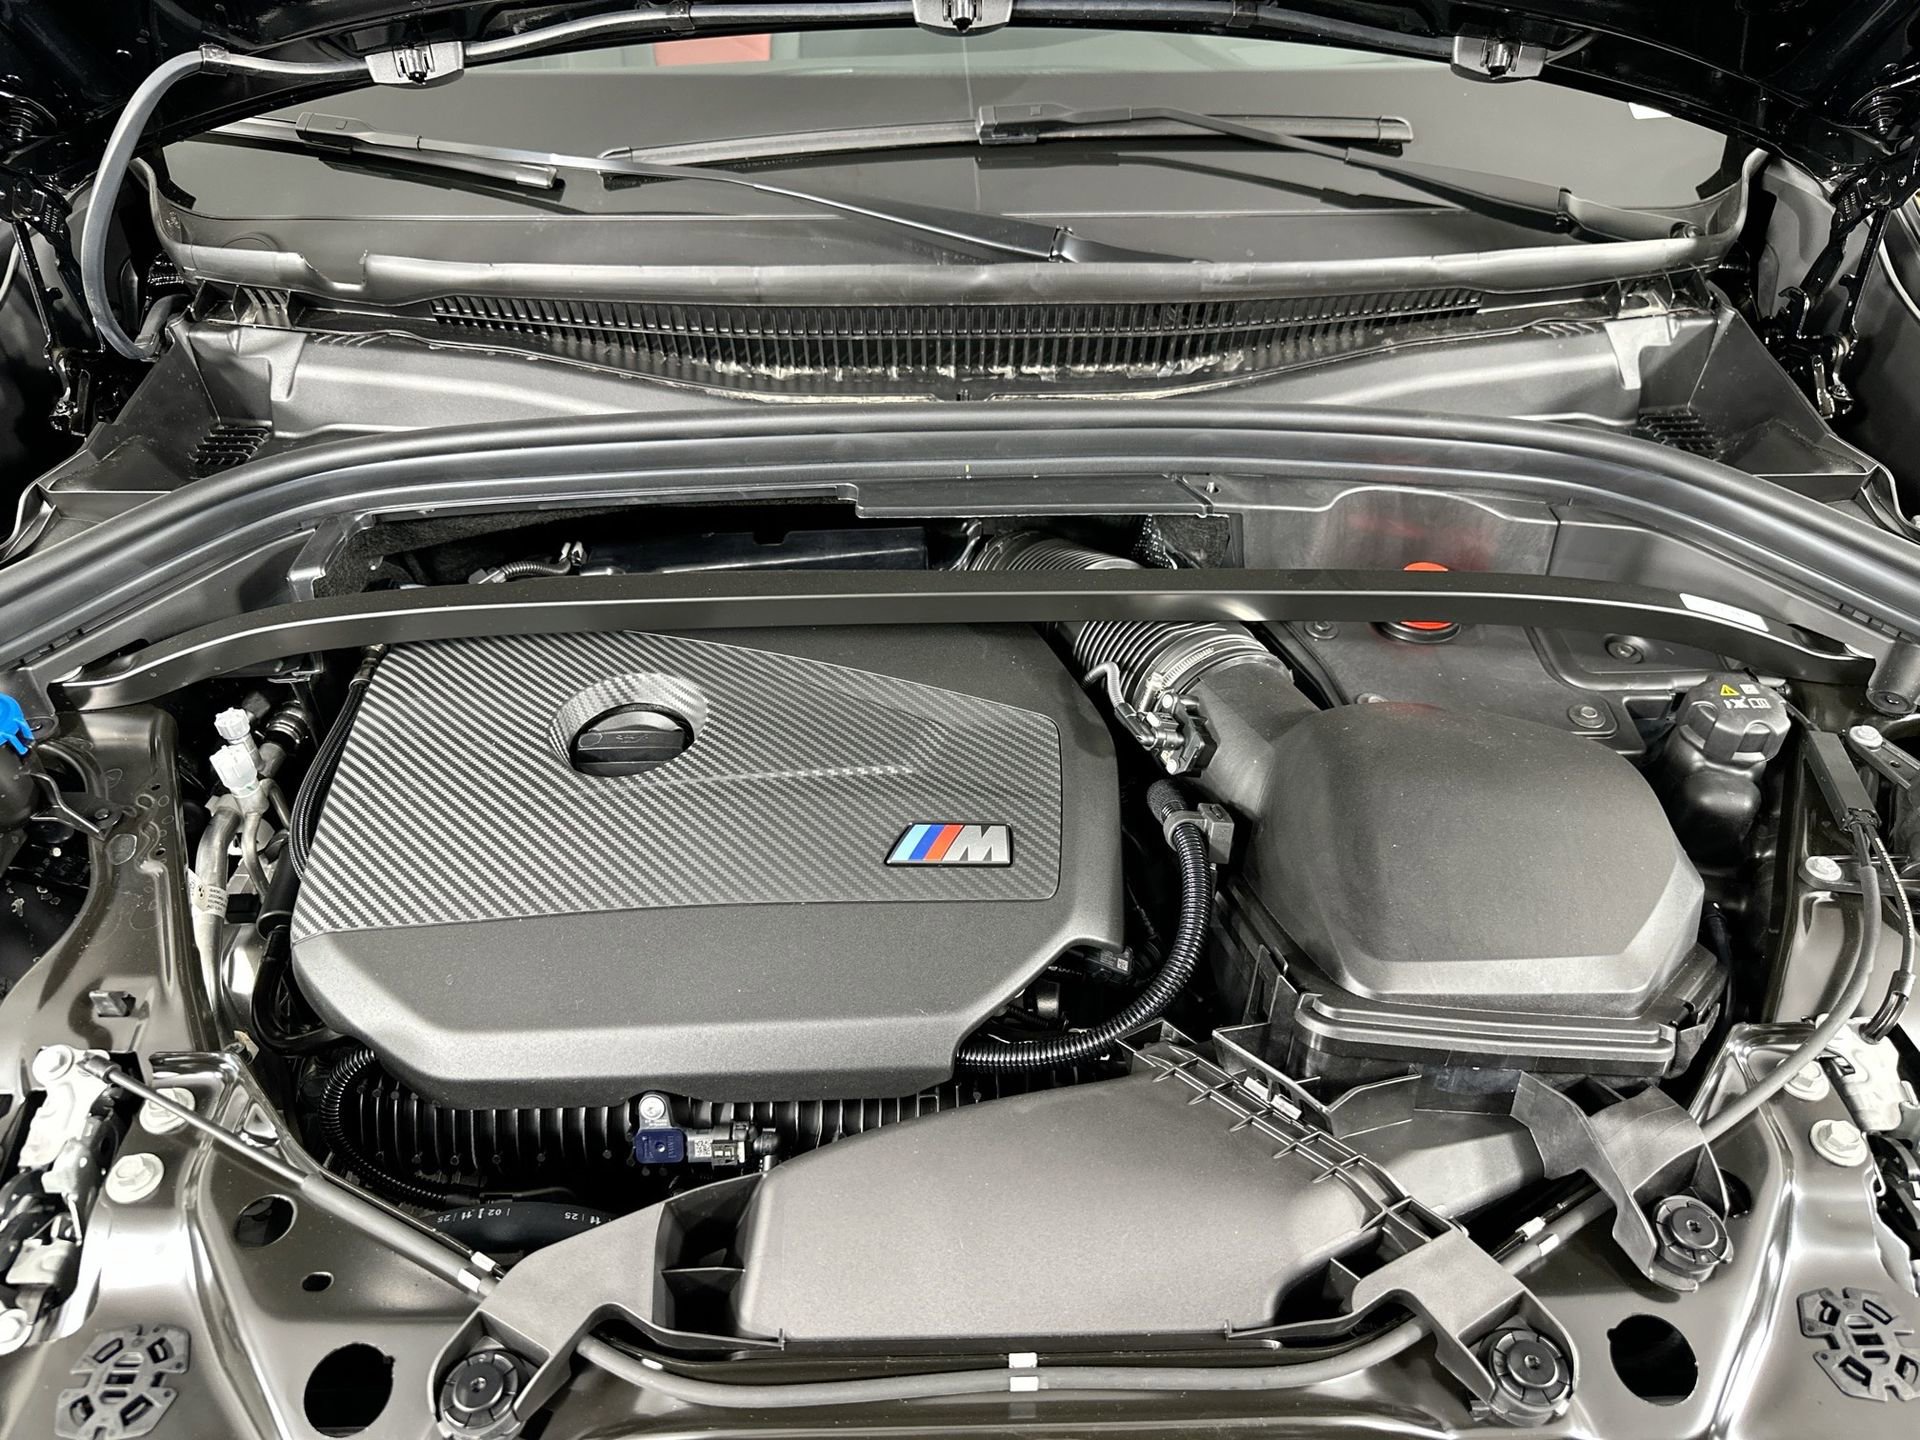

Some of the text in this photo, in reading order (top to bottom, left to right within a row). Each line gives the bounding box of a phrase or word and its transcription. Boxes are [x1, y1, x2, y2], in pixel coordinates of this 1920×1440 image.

[942, 825, 1009, 861] M
[487, 1208, 502, 1217] 02
[564, 1211, 579, 1221] 25
[437, 1214, 451, 1223] 25
